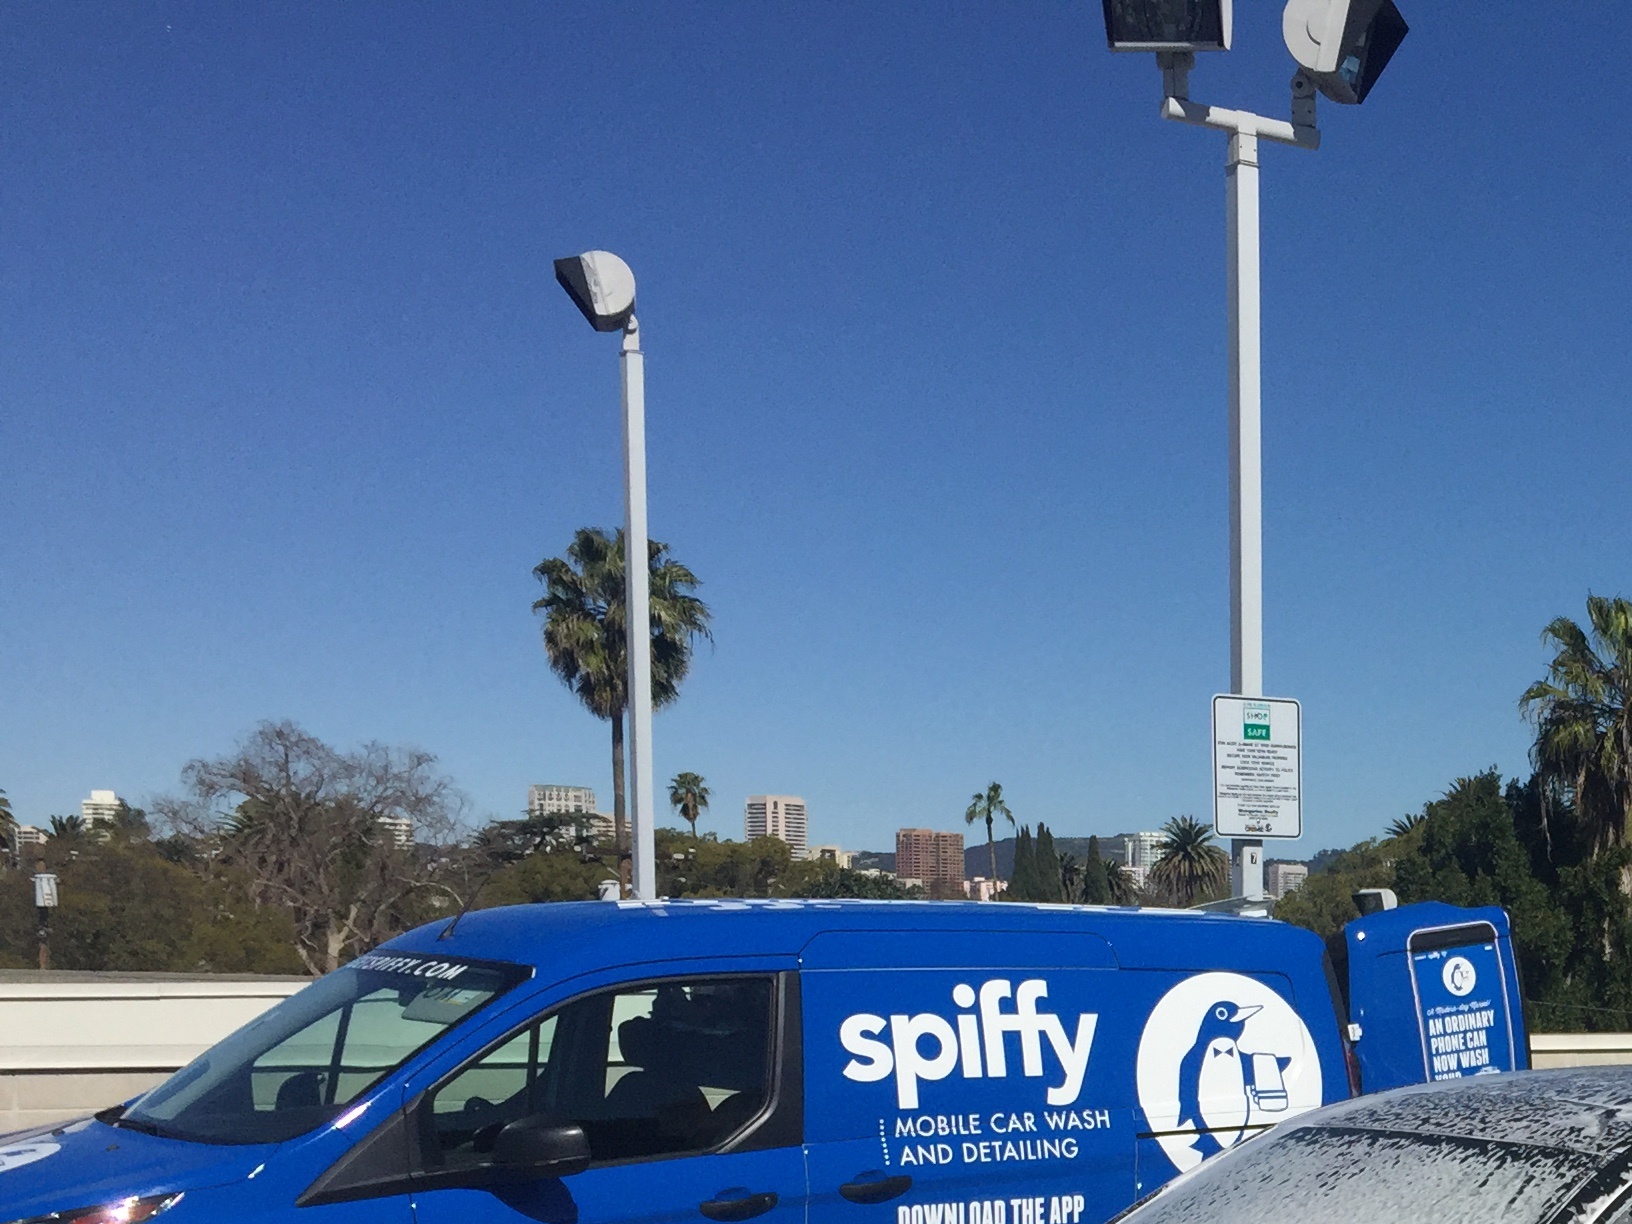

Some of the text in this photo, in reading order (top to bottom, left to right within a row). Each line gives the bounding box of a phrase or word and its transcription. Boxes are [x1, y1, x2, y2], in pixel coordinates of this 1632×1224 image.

[1247, 727, 1267, 737] SAFE
[346, 955, 469, 980] TSPIFFY.COM
[1428, 1009, 1494, 1036] AN ORDINARY
[840, 979, 1098, 1110] spiffy
[1431, 1030, 1487, 1054] PHONE CAN
[1433, 1048, 1489, 1073] NOW WASH
[895, 1109, 1111, 1138] MOBILE CAR WASH
[900, 1138, 1079, 1166] AND DETAILING
[1050, 1195, 1084, 1224] APP
